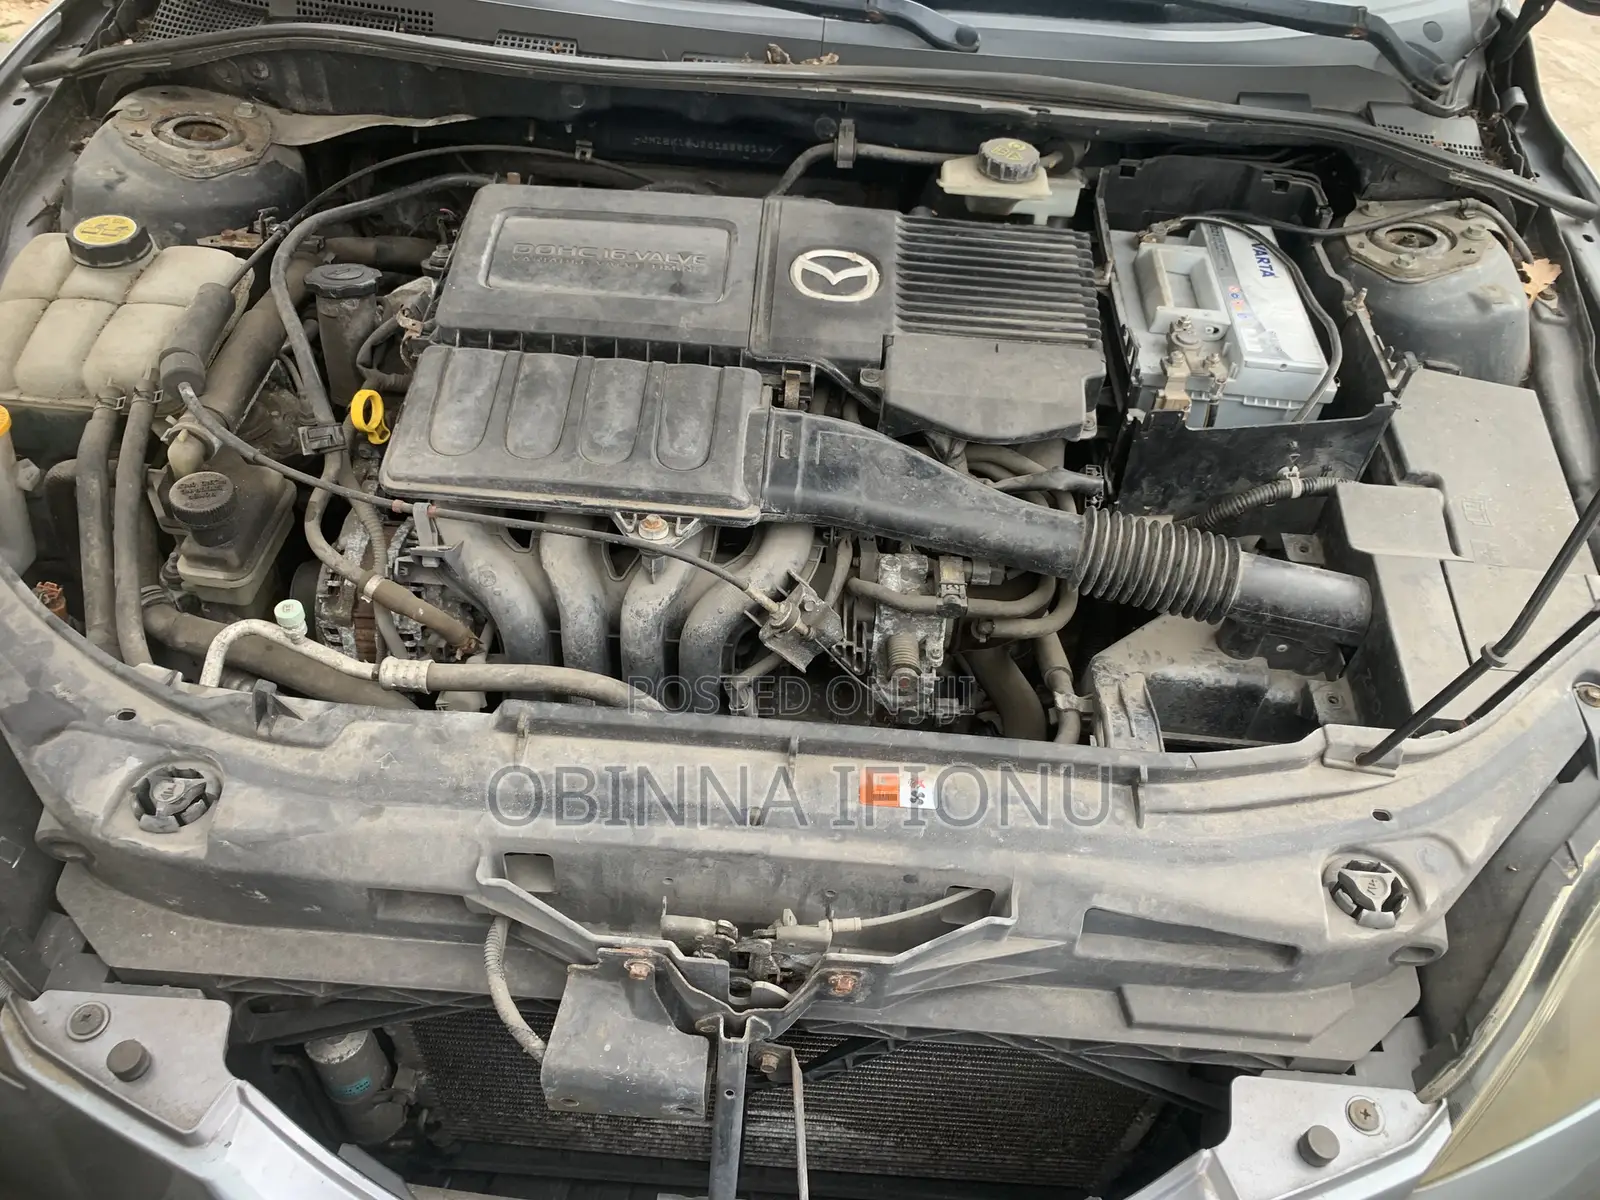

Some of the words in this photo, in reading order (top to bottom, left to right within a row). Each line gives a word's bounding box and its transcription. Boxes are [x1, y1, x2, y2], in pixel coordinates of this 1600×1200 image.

[512, 242, 598, 259] DOHC
[603, 247, 707, 266] 16-VALVE
[1251, 242, 1276, 278] VARTA
